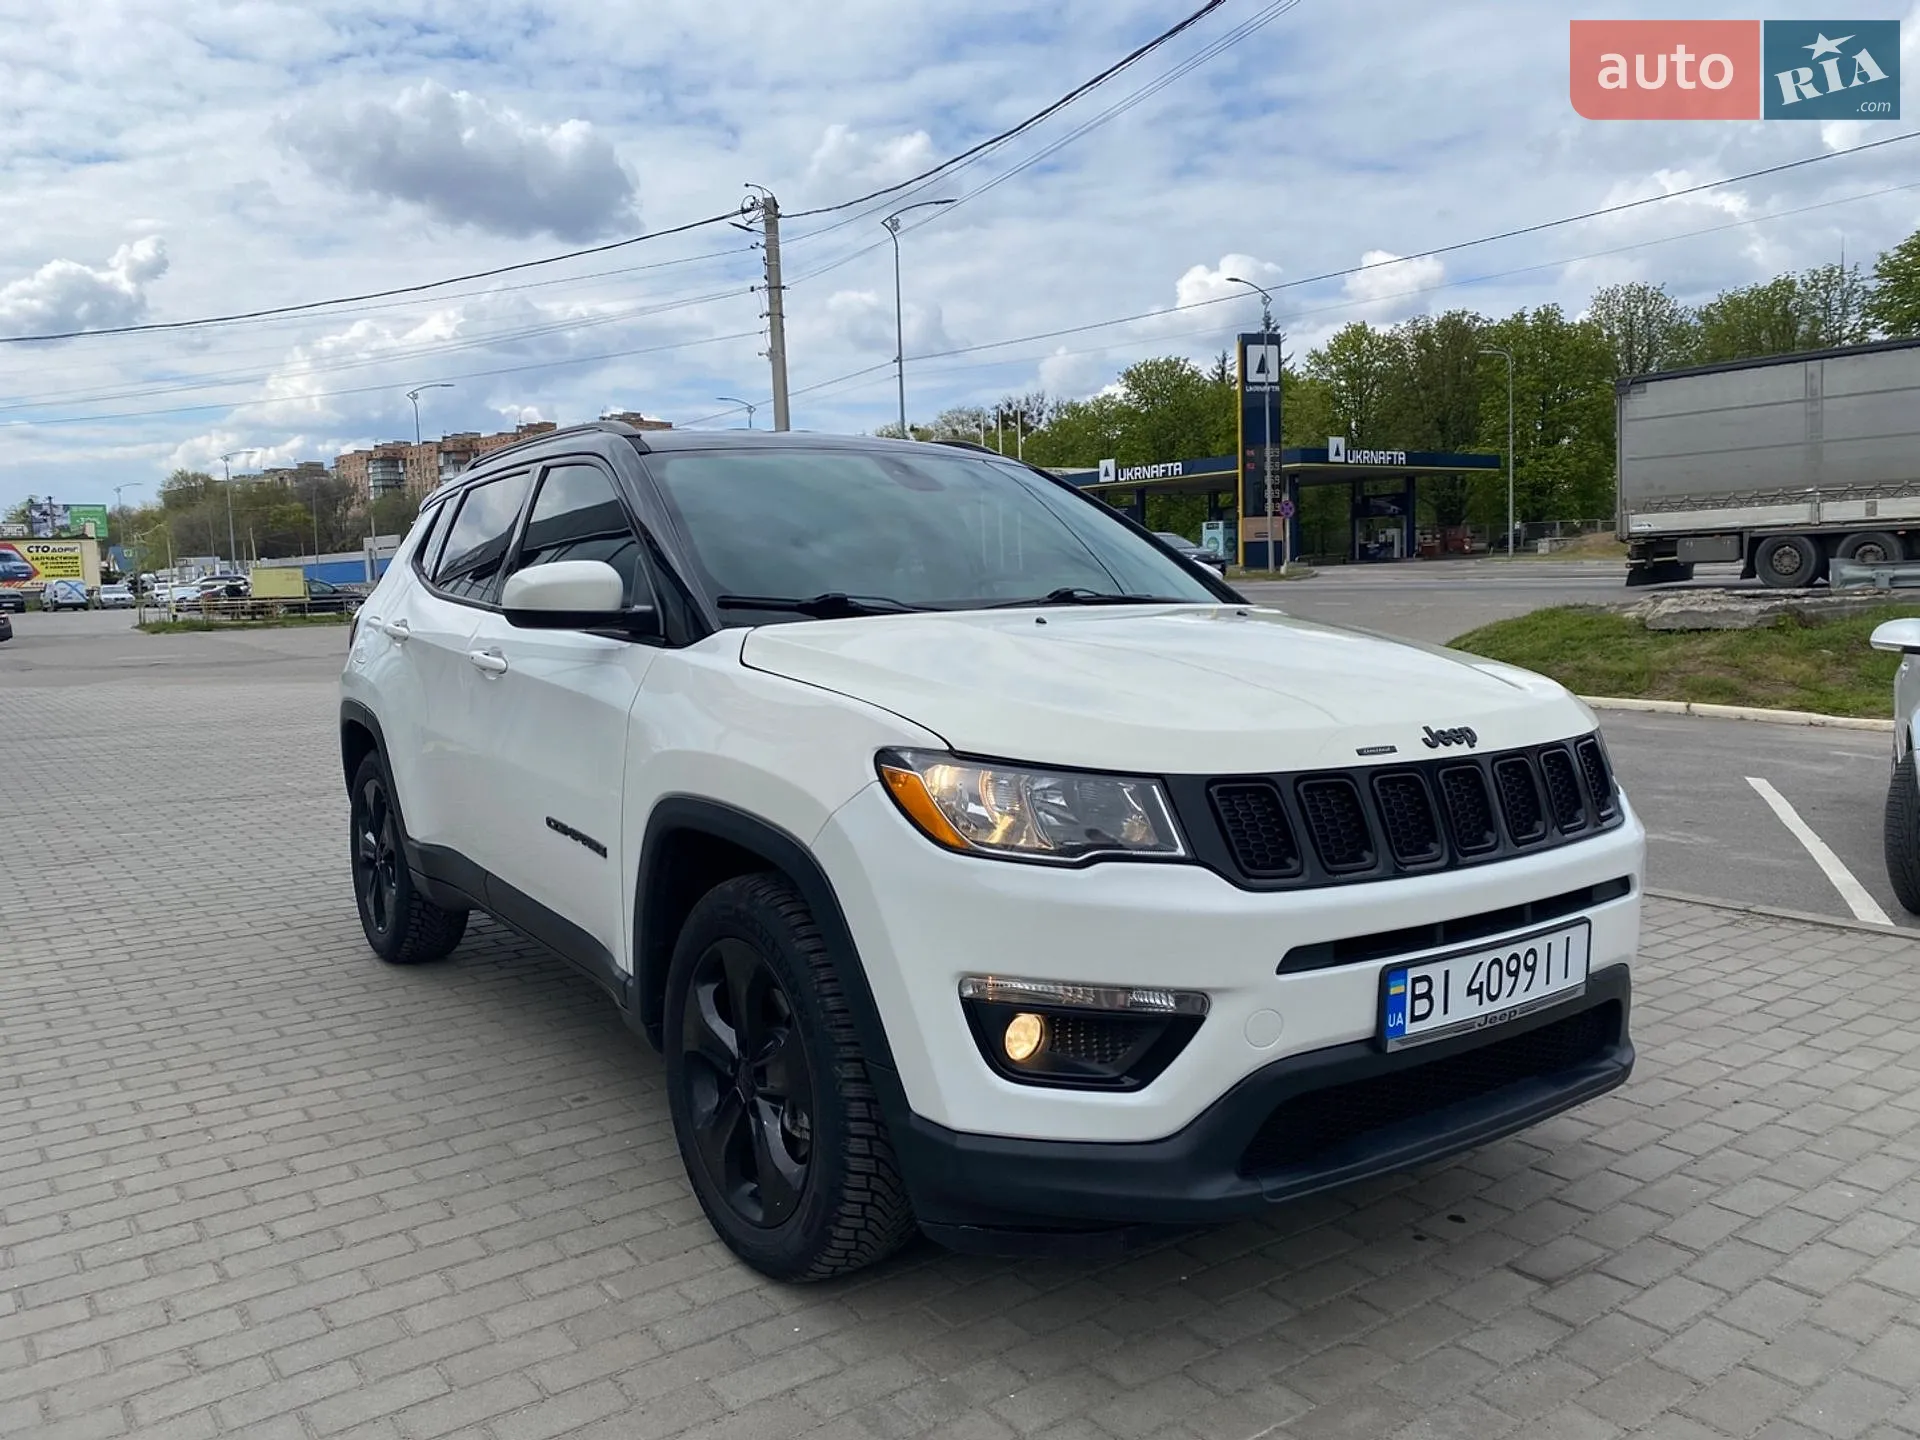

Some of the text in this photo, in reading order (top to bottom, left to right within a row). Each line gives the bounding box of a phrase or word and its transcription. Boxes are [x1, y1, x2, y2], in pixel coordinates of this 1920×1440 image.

[1347, 449, 1406, 465] UKRNAFTA
[1118, 462, 1183, 481] UKRNAFTA
[27, 545, 50, 553] СТО
[1421, 726, 1477, 749] Jeep
[1410, 969, 1449, 1024] BI
[1466, 947, 1538, 1006] 4099
[1388, 1011, 1404, 1028] UA
[1477, 1007, 1518, 1027] Jeep
